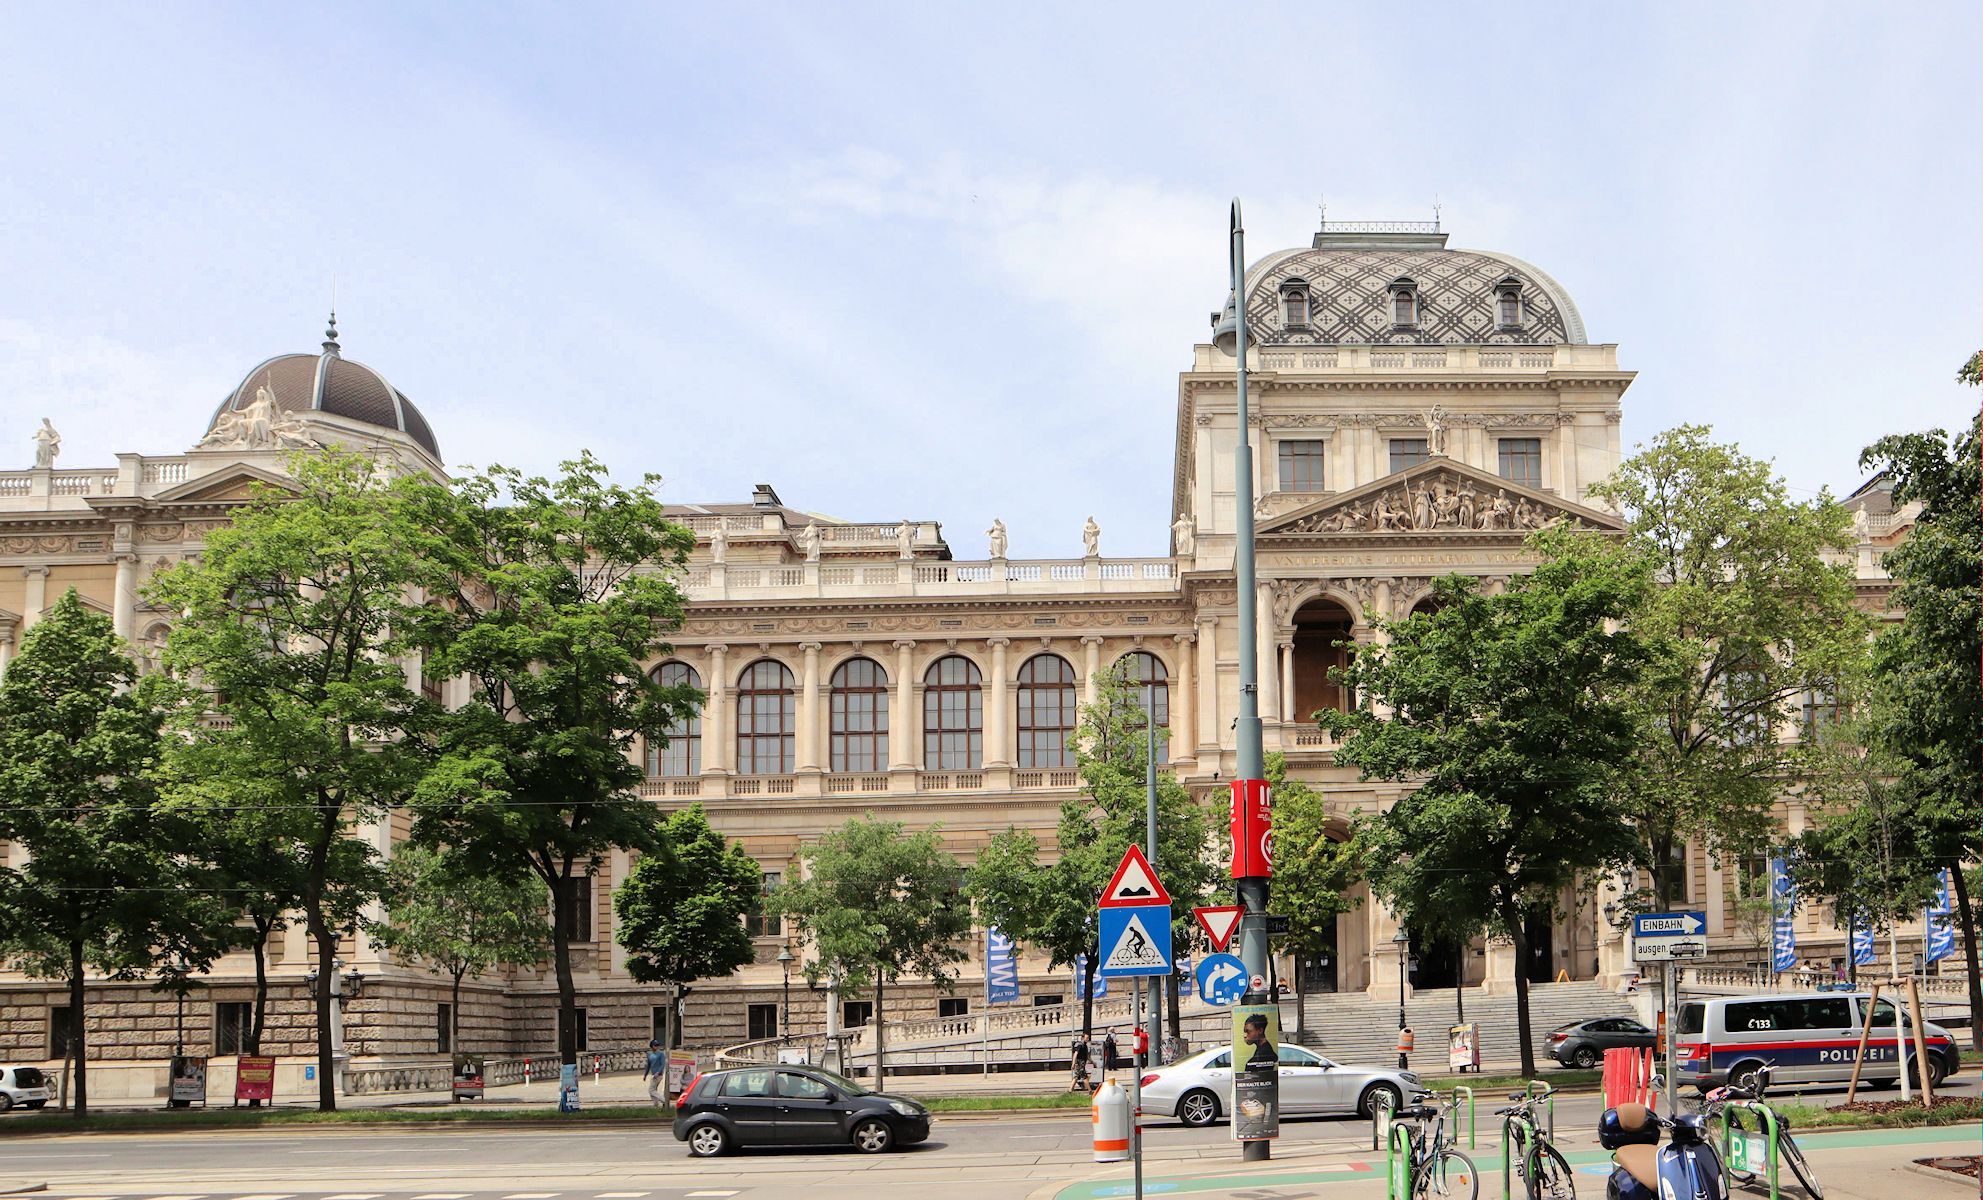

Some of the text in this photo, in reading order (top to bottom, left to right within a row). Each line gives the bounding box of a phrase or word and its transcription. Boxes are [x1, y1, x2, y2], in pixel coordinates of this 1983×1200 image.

[1643, 920, 1683, 930] EINBAHN
[1638, 945, 1668, 955] ausgen.
[1732, 1136, 1743, 1166] P
